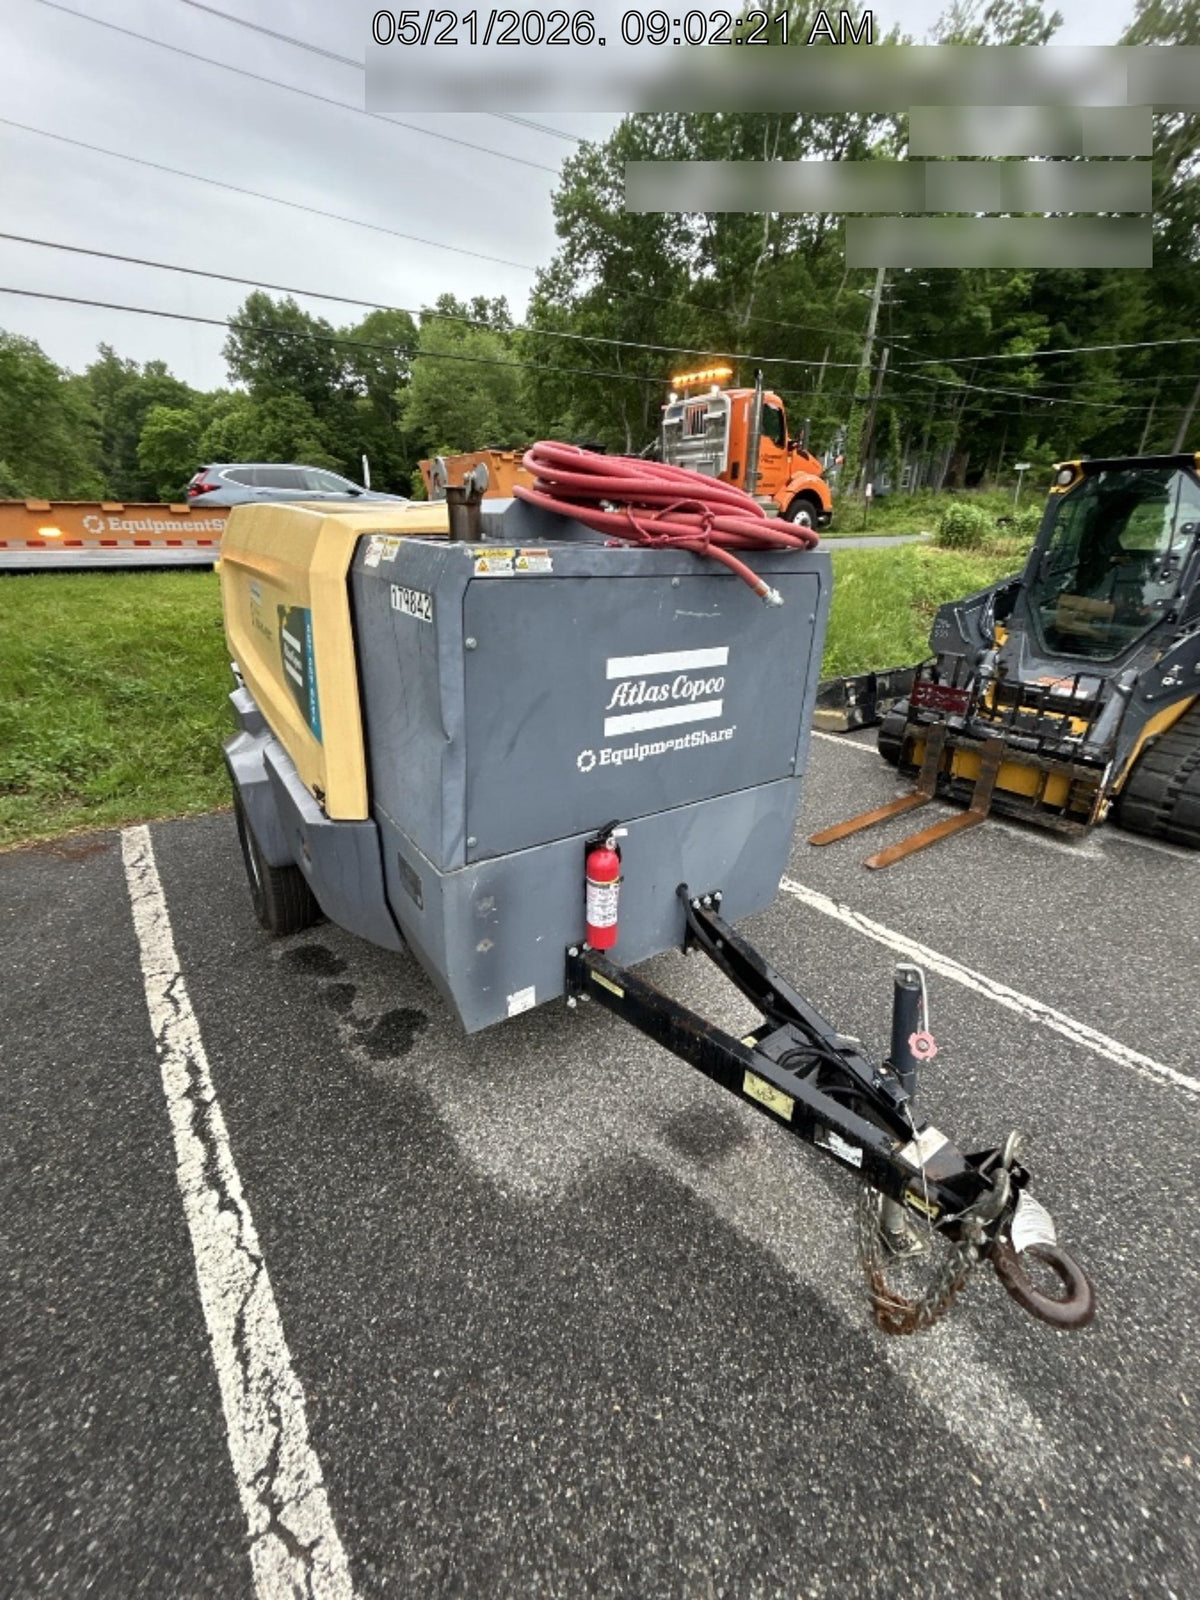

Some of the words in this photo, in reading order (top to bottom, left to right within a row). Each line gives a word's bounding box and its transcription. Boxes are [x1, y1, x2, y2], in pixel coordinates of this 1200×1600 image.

[392, 588, 431, 620] 179842
[605, 679, 669, 710] Atlas
[672, 674, 725, 701] Copco
[599, 727, 734, 766] EquipmentShare
